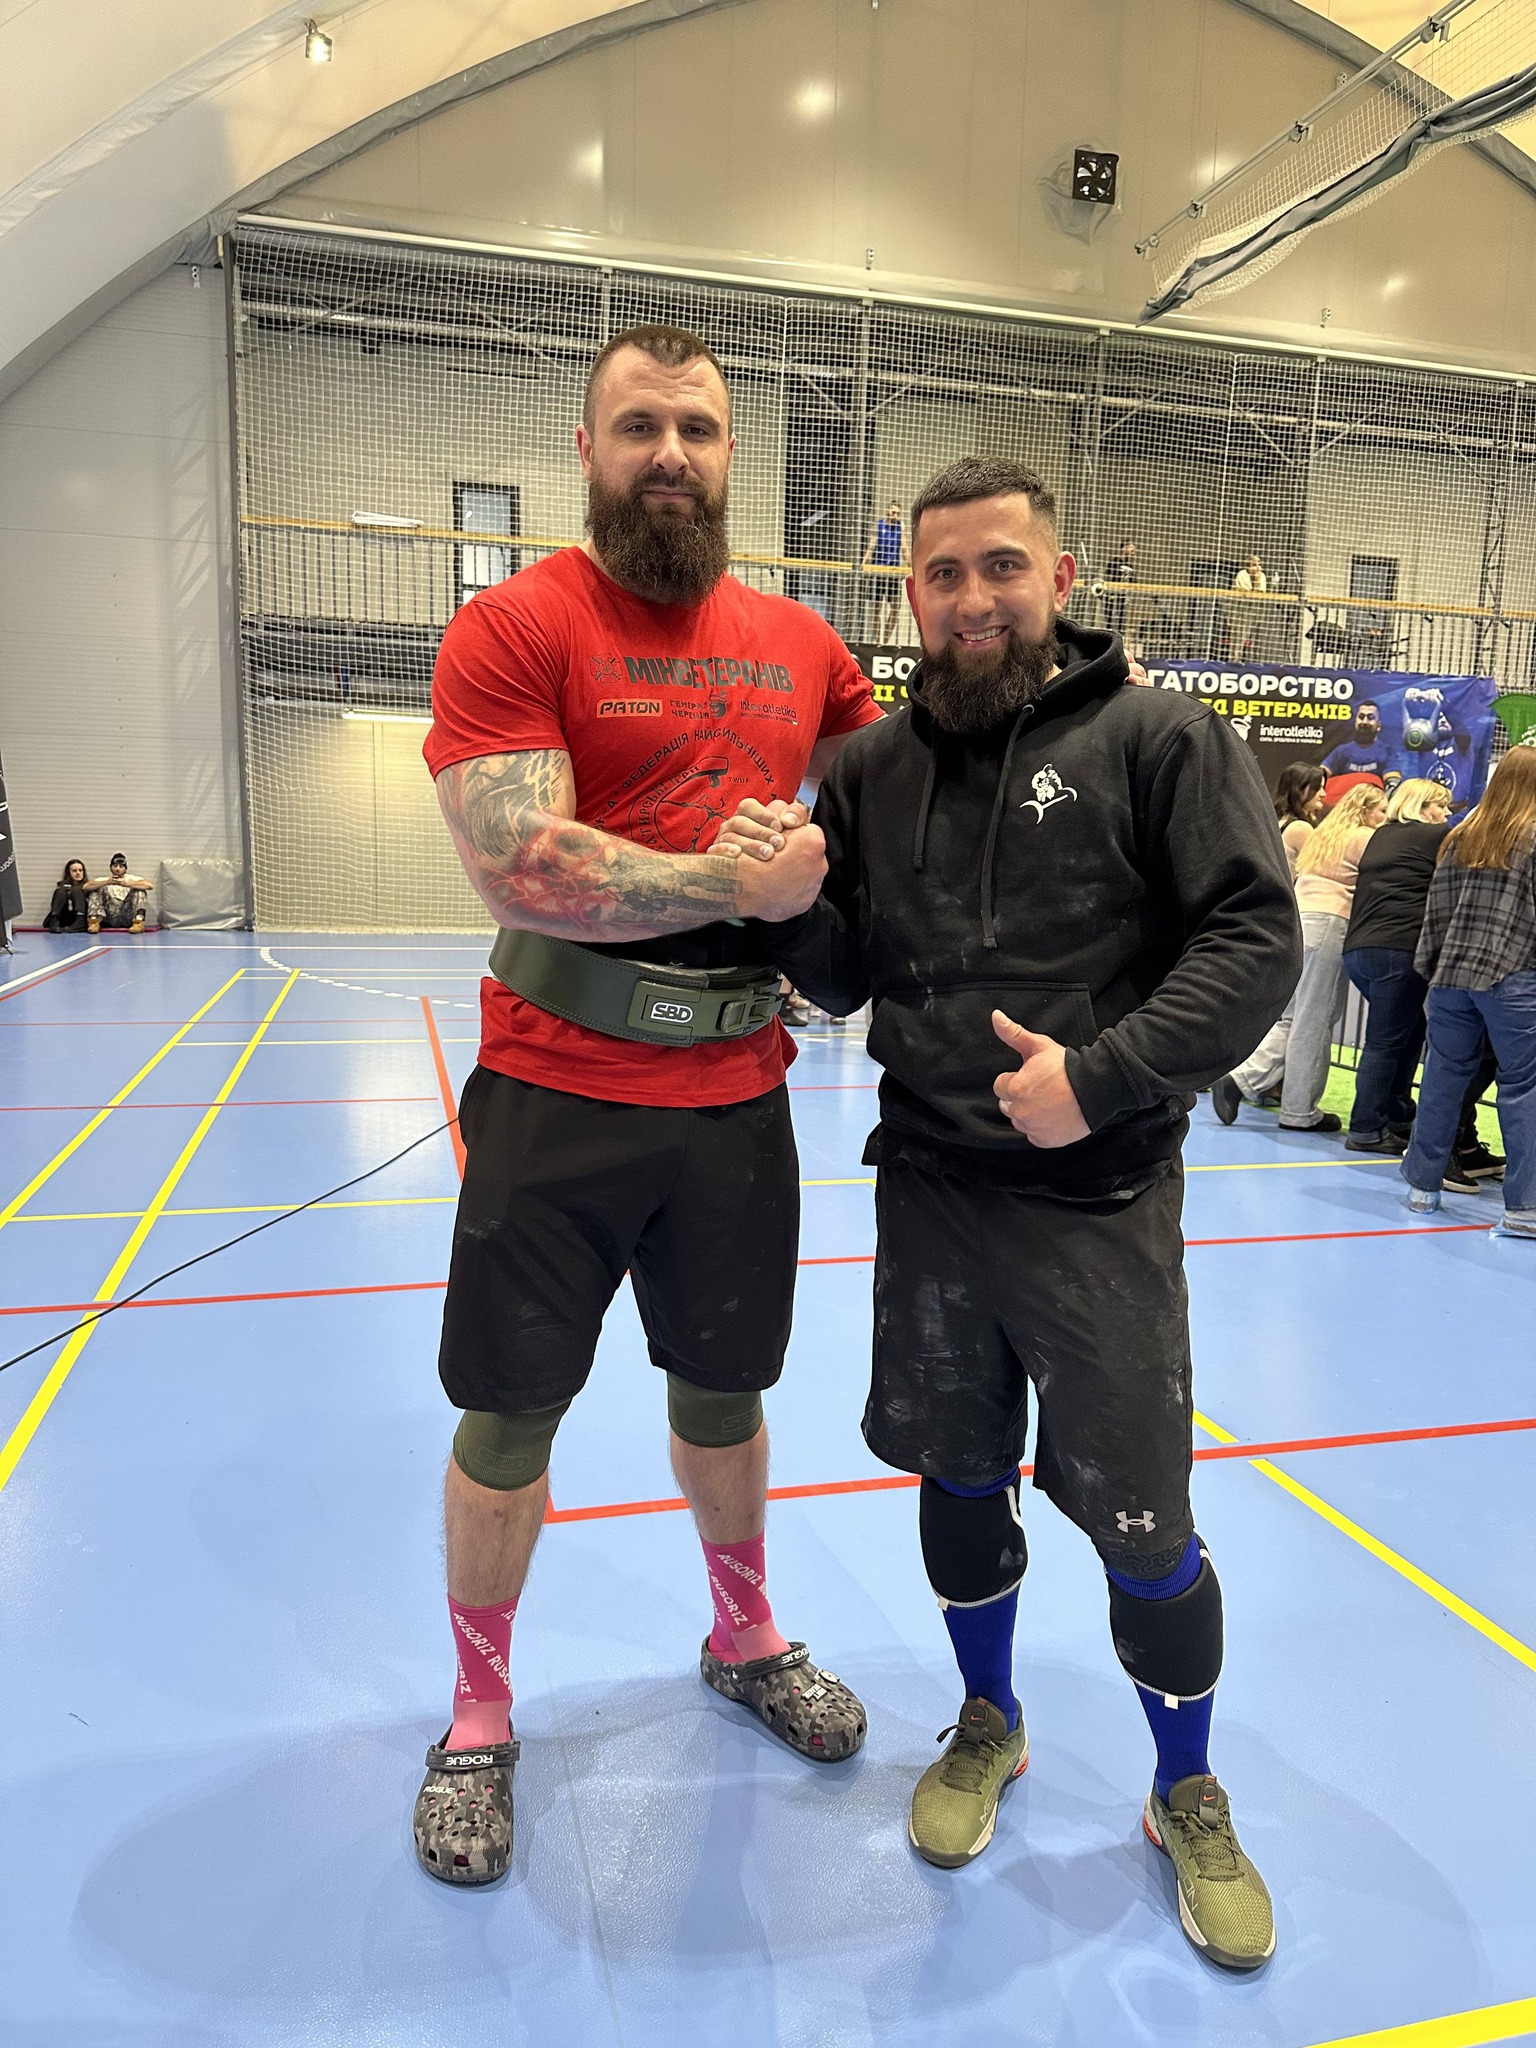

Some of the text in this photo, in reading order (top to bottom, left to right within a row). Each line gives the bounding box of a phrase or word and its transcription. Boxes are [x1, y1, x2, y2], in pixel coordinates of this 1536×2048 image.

[623, 656, 794, 693] МІНВЕТЕРАНІВ
[1148, 669, 1354, 700] ГАТОБОРСТВО
[599, 701, 660, 715] PATON
[1233, 700, 1352, 720] ВЕТЕРАНІВ
[1259, 723, 1324, 739] interatletika
[622, 726, 774, 789] ФЕДЕРАЦІЯ НАЙСИЛЬНІШИХ
[651, 1002, 694, 1023] SBD
[717, 1553, 762, 1585] RUSORIZ
[711, 1575, 748, 1626] RUSORIZ
[453, 1612, 496, 1656] RUSORIZ
[781, 1648, 808, 1664] OGUE
[445, 1755, 493, 1766] ROGUE
[423, 1785, 455, 1794] ROGUE
